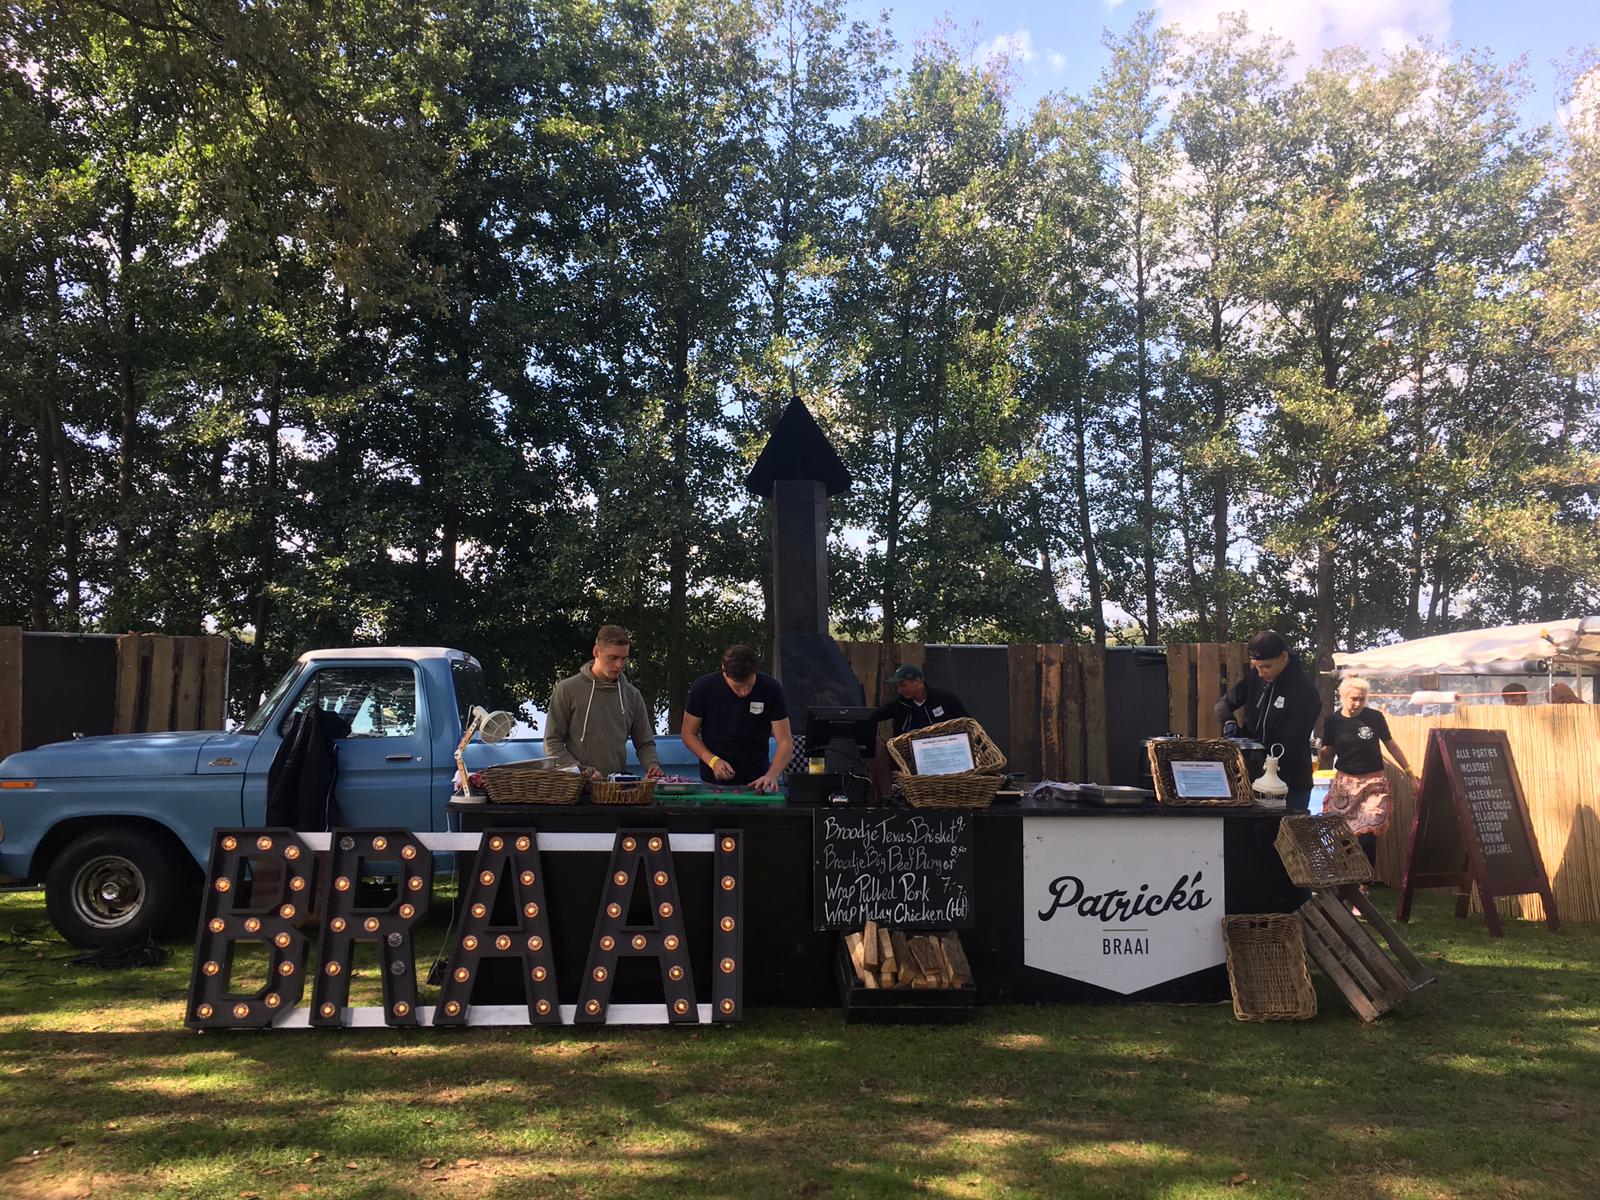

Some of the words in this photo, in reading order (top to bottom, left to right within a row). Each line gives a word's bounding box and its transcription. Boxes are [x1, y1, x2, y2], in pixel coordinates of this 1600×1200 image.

[1456, 749, 1471, 759] ALLE
[1472, 801, 1492, 811] WITTE
[824, 816, 879, 848] Broodje
[875, 814, 913, 844] Texas
[907, 816, 958, 844] Brisket
[824, 844, 865, 875] Broodje
[865, 845, 886, 873] Big
[887, 845, 915, 872] Beef
[916, 846, 957, 876] Burger
[825, 873, 856, 906] Wrap
[855, 873, 898, 903] Pulled
[899, 872, 930, 902] Pork
[1038, 870, 1212, 922] Patrick's
[825, 898, 857, 923] Wrap
[859, 902, 892, 924] Malay
[894, 902, 946, 924] Chicken
[184, 827, 744, 1028] BRAAI
[1103, 938, 1149, 955] BRAAI
